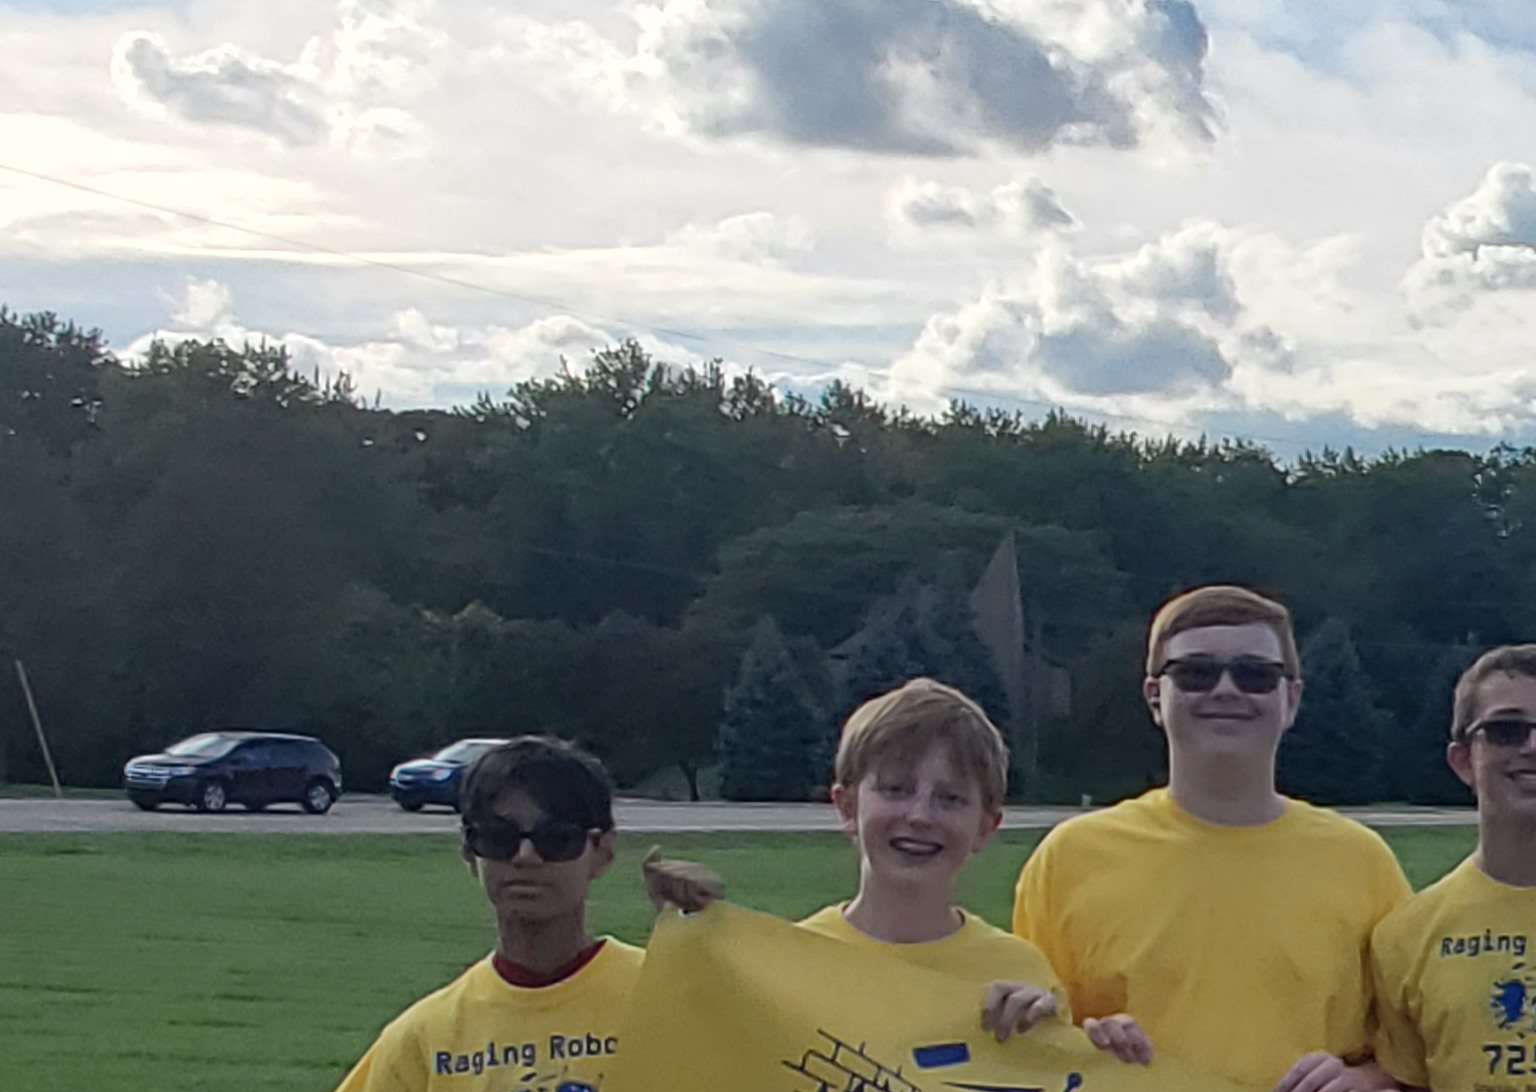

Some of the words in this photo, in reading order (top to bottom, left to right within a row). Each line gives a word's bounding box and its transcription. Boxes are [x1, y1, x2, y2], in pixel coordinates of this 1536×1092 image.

[1440, 928, 1527, 957] Raging
[436, 1042, 537, 1075] Raging
[549, 1032, 618, 1060] Robo
